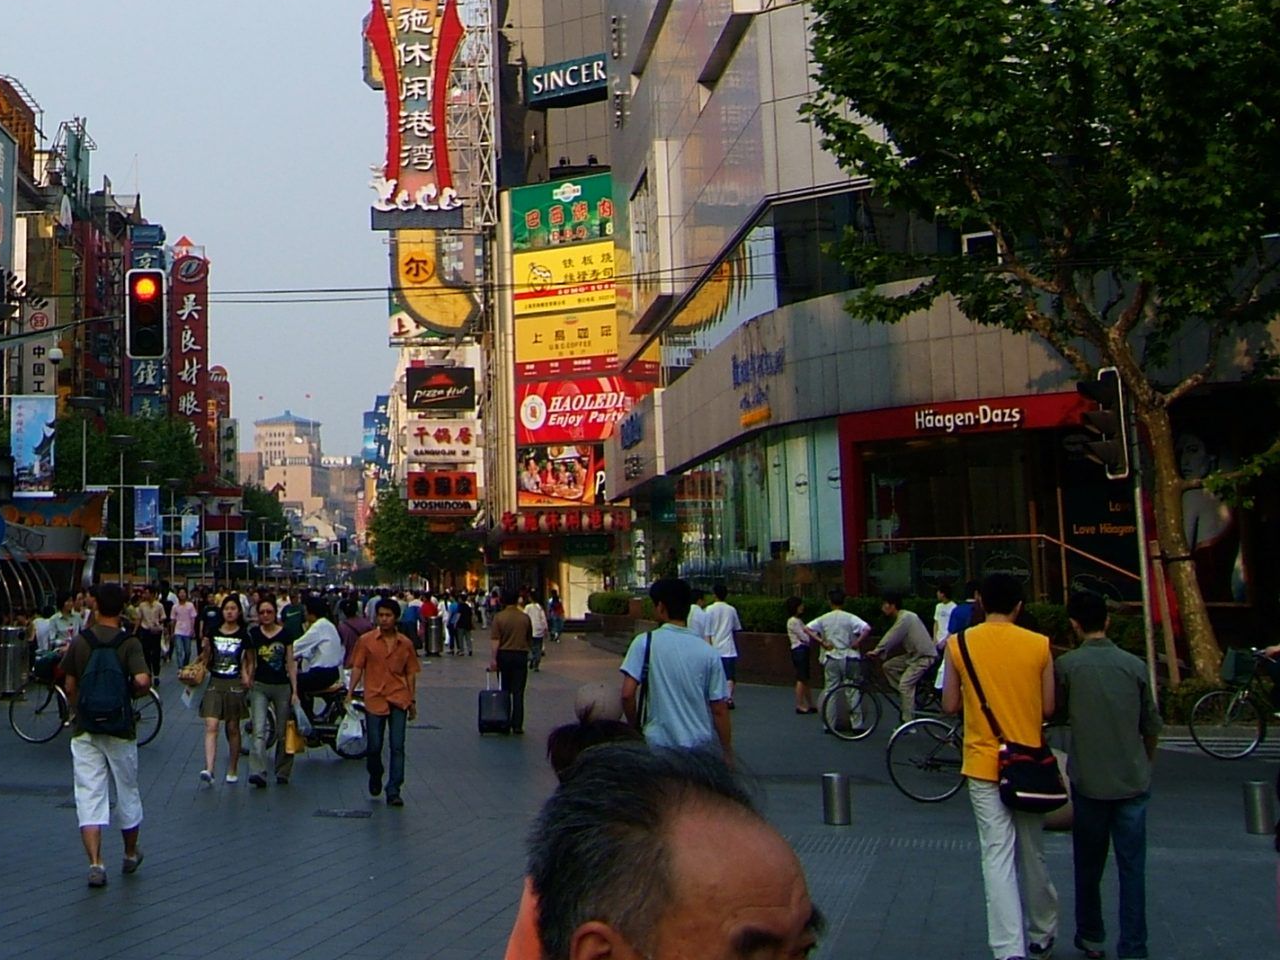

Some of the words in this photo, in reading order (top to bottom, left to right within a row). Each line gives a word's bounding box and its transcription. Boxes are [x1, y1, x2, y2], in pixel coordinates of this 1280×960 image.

[405, 257, 429, 277] 尔
[548, 391, 625, 413] HAOLEDI
[548, 413, 584, 428] Enjoy
[589, 410, 626, 424] Party
[915, 404, 1021, 432] Häagen-Dazs
